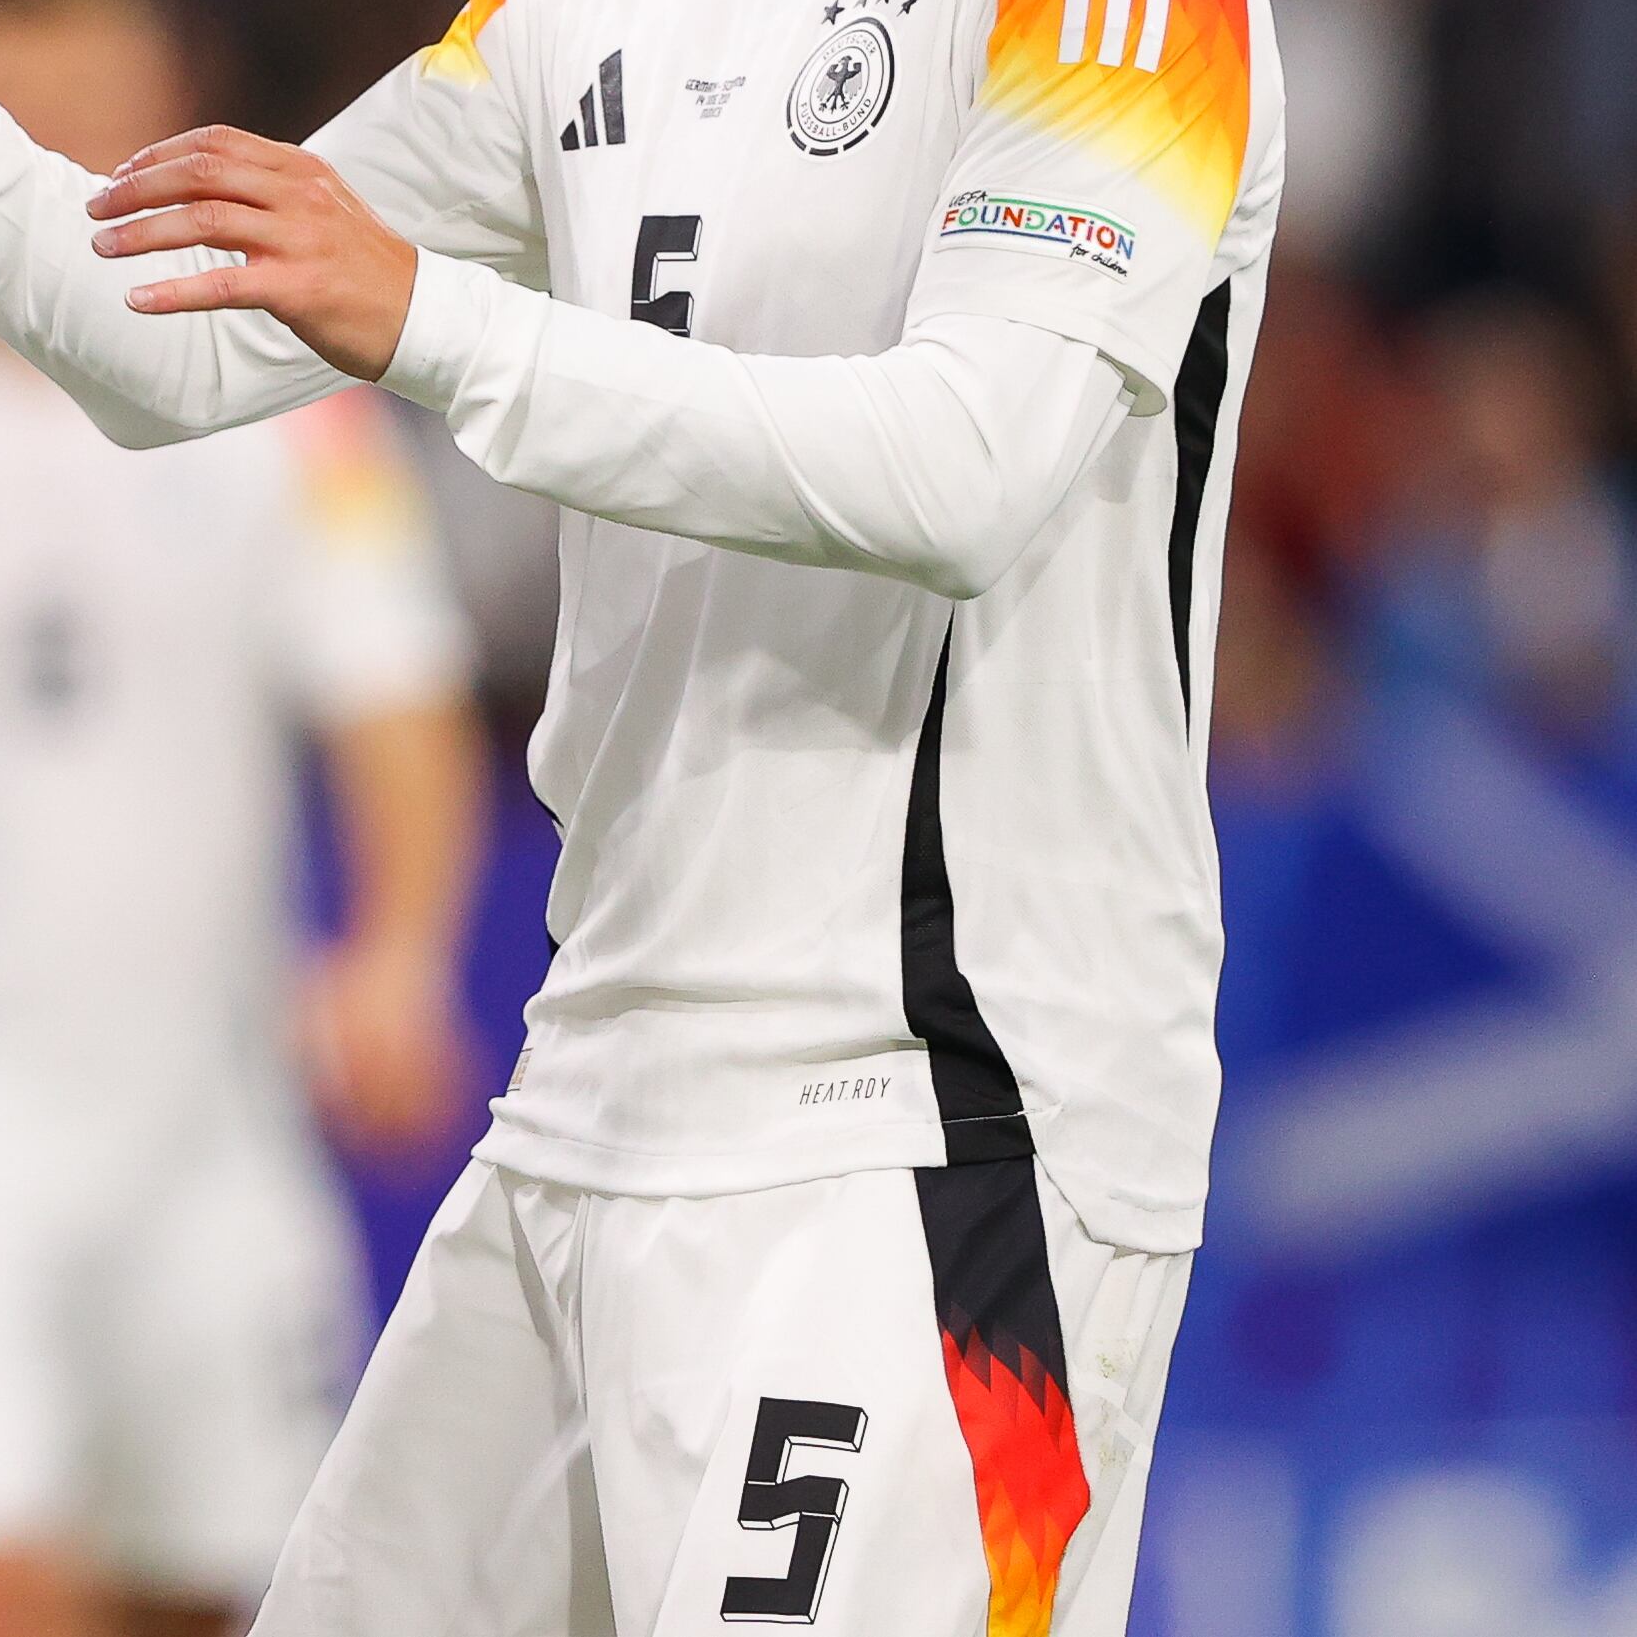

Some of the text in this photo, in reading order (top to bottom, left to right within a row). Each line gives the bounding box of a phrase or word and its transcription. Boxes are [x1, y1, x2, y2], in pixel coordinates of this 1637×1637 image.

[800, 97, 872, 137] FUSSBALL-BUND
[948, 189, 987, 207] UEFA
[1069, 243, 1089, 257] for
[799, 1076, 891, 1105] HEAT.RDY
[720, 1396, 869, 1625] 5
